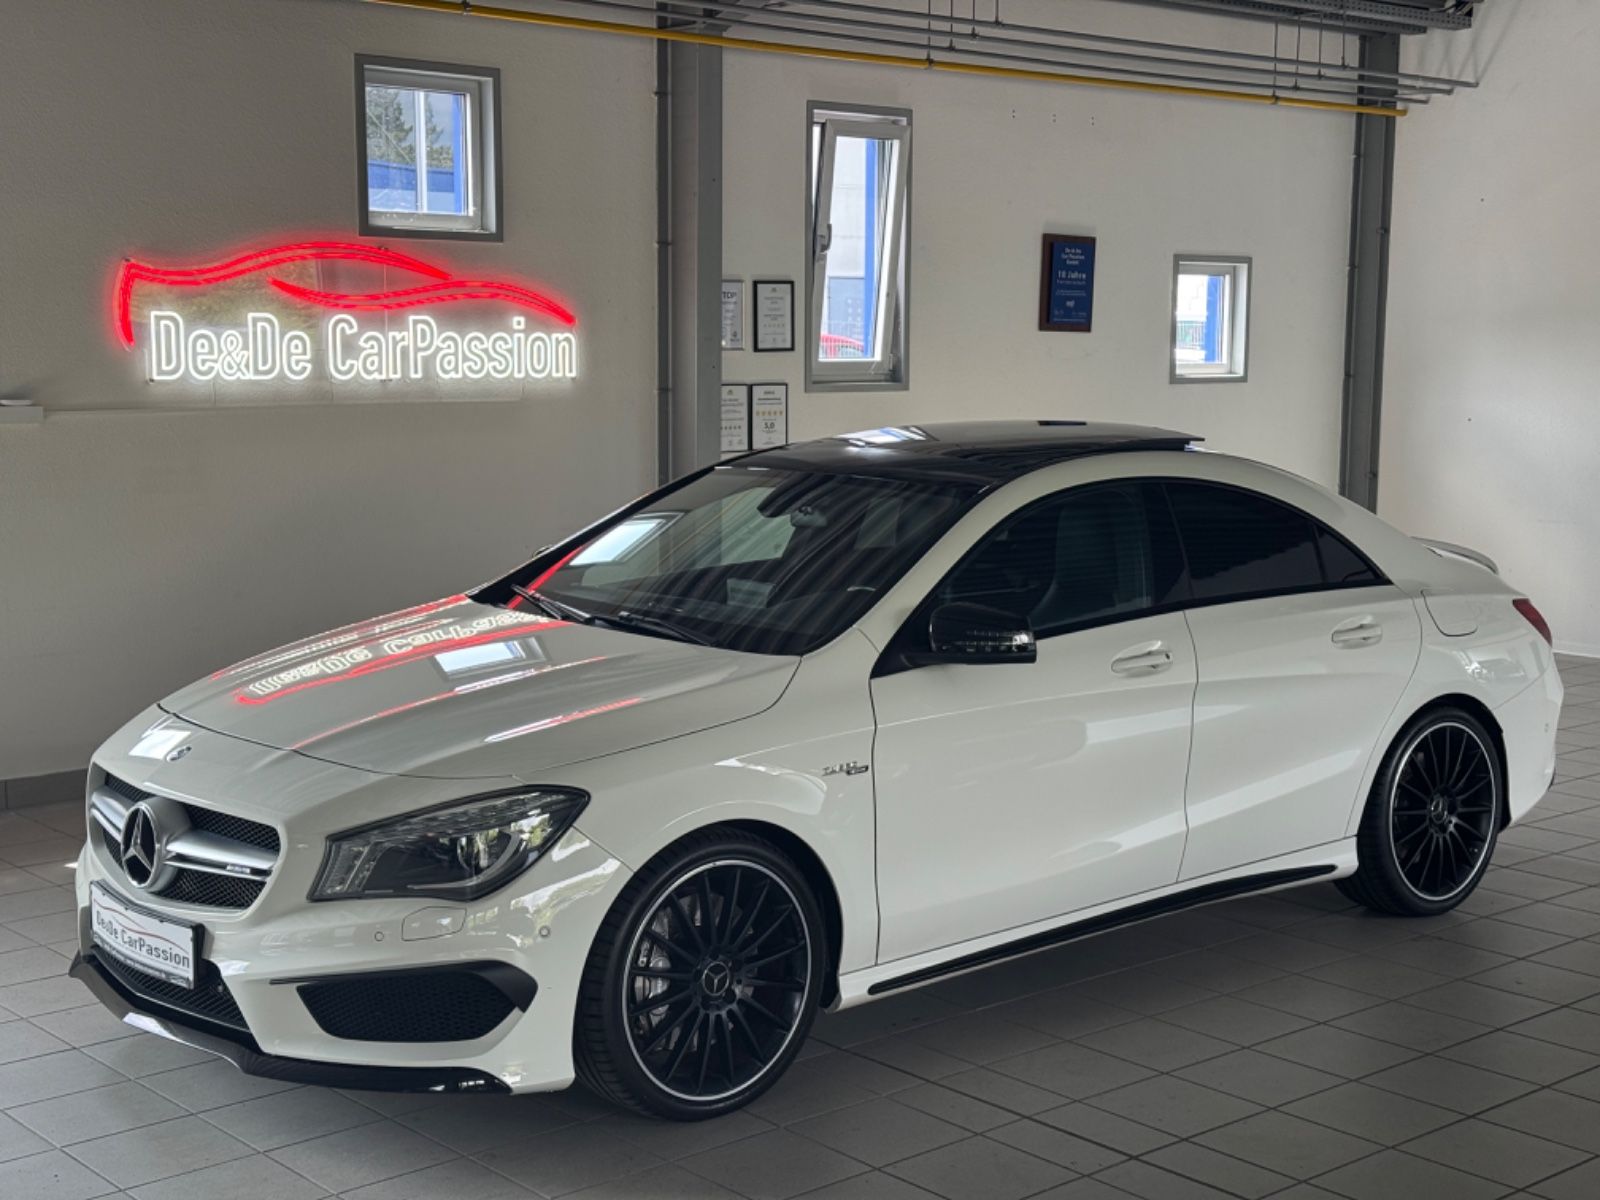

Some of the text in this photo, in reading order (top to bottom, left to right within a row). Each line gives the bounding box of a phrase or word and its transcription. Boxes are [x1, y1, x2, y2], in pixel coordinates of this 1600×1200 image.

[150, 310, 577, 380] De&De CarPassion
[121, 929, 190, 969] CarPassion
